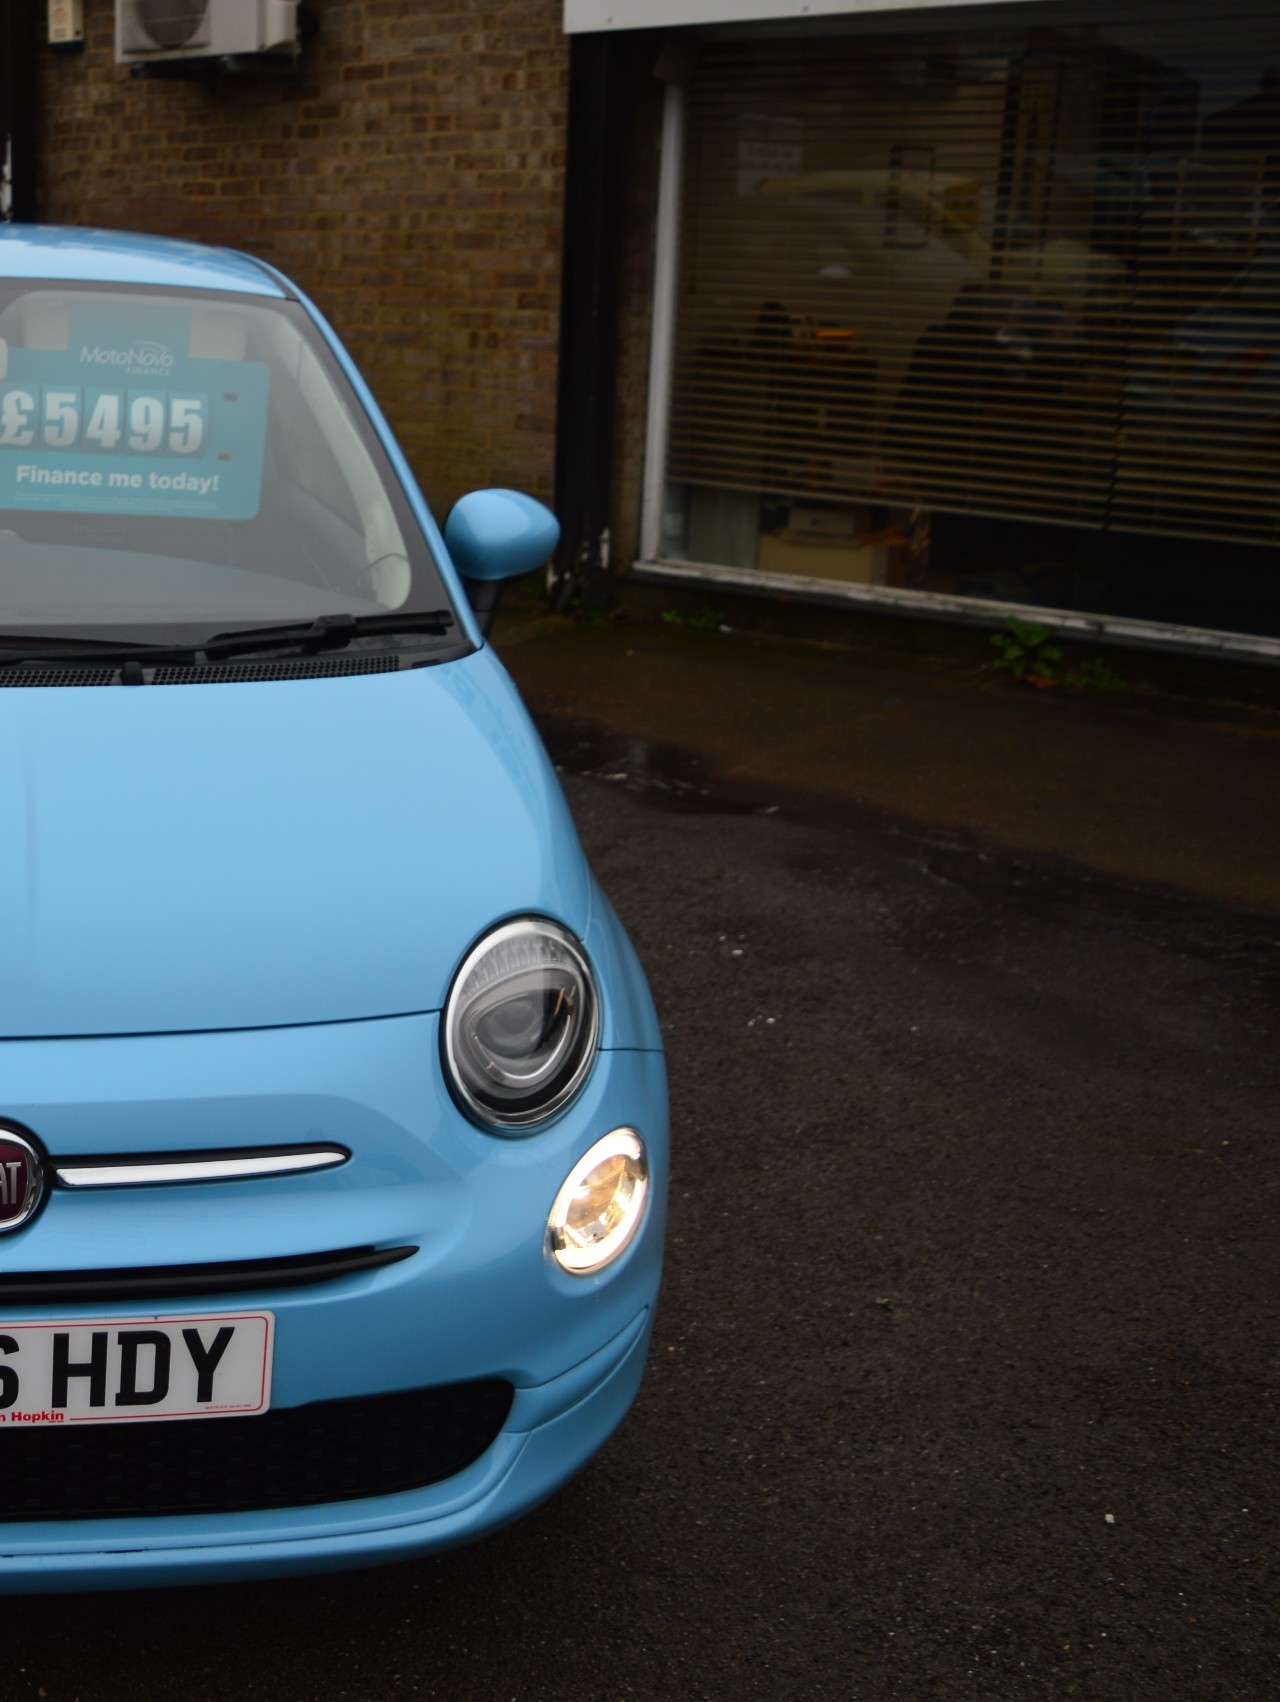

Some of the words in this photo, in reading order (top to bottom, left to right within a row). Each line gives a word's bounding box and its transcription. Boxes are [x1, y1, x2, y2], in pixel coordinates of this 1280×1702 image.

[80, 345, 174, 368] MotoNovo
[0, 390, 204, 454] £5495
[16, 465, 103, 487] Finance
[108, 472, 142, 488] me
[149, 471, 220, 495] today!
[51, 1326, 236, 1408] HDY
[11, 1410, 65, 1423] Hopkin
